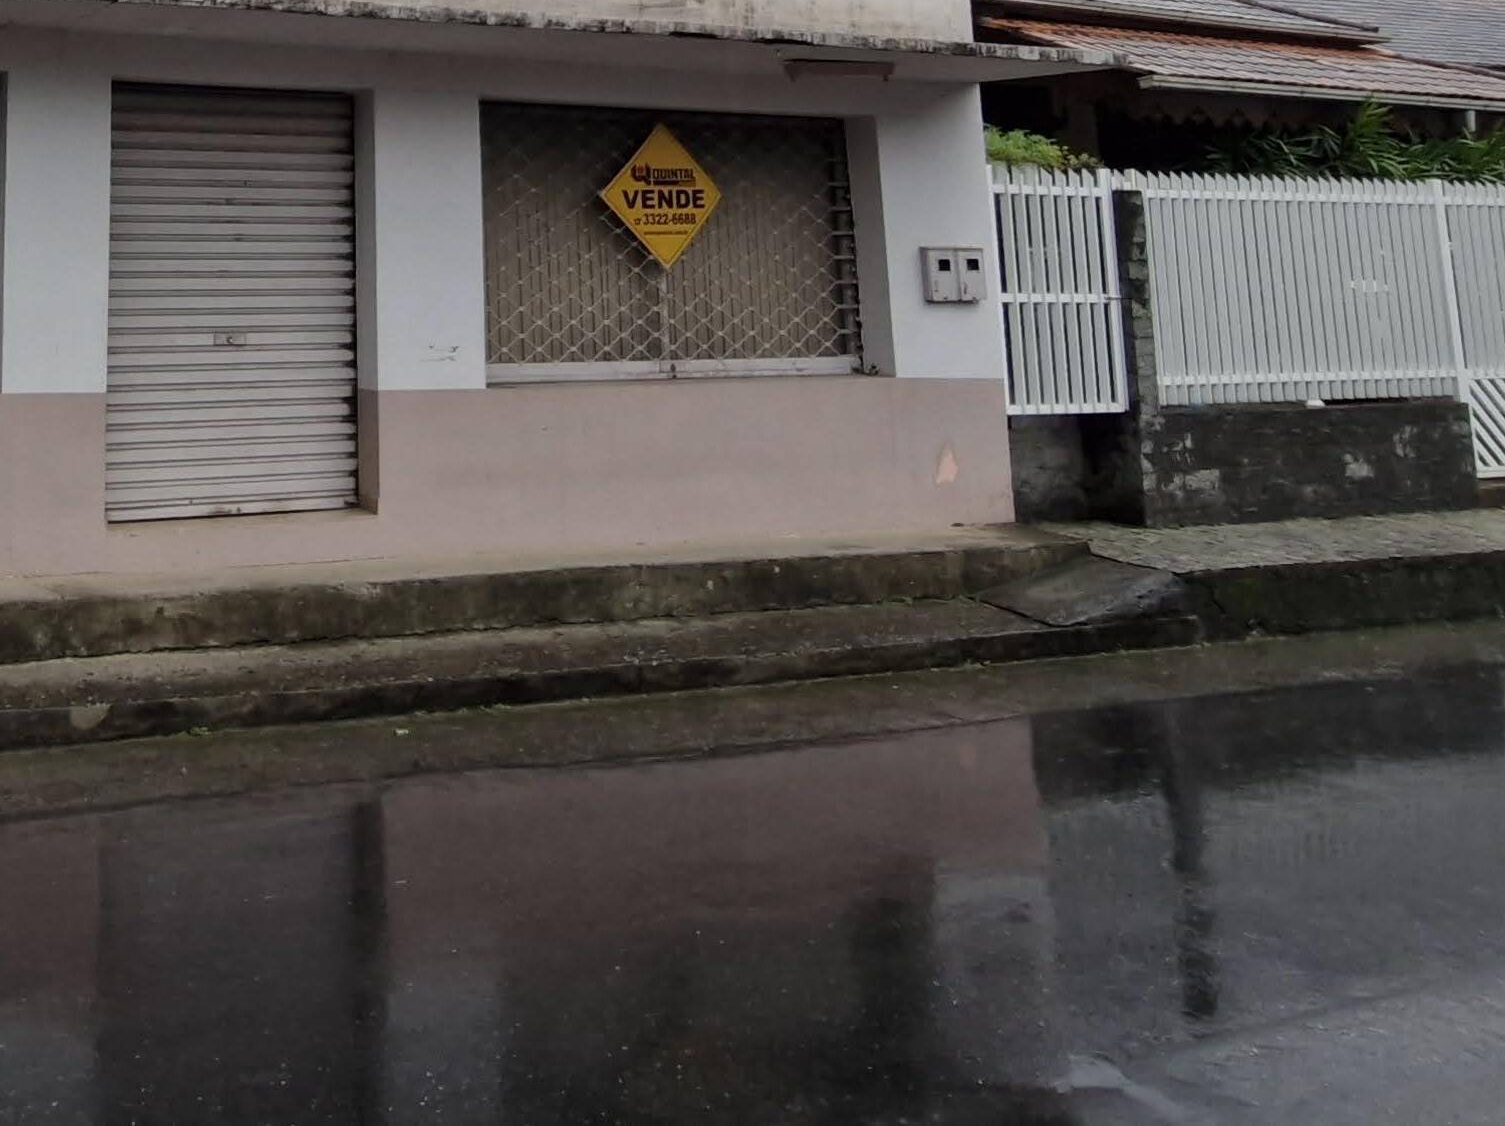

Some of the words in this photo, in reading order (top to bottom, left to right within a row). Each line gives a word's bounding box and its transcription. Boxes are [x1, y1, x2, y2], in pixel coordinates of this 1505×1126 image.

[652, 168, 695, 180] QUINTAL
[622, 189, 705, 209] VENDE
[643, 212, 697, 225] 3322-6688
